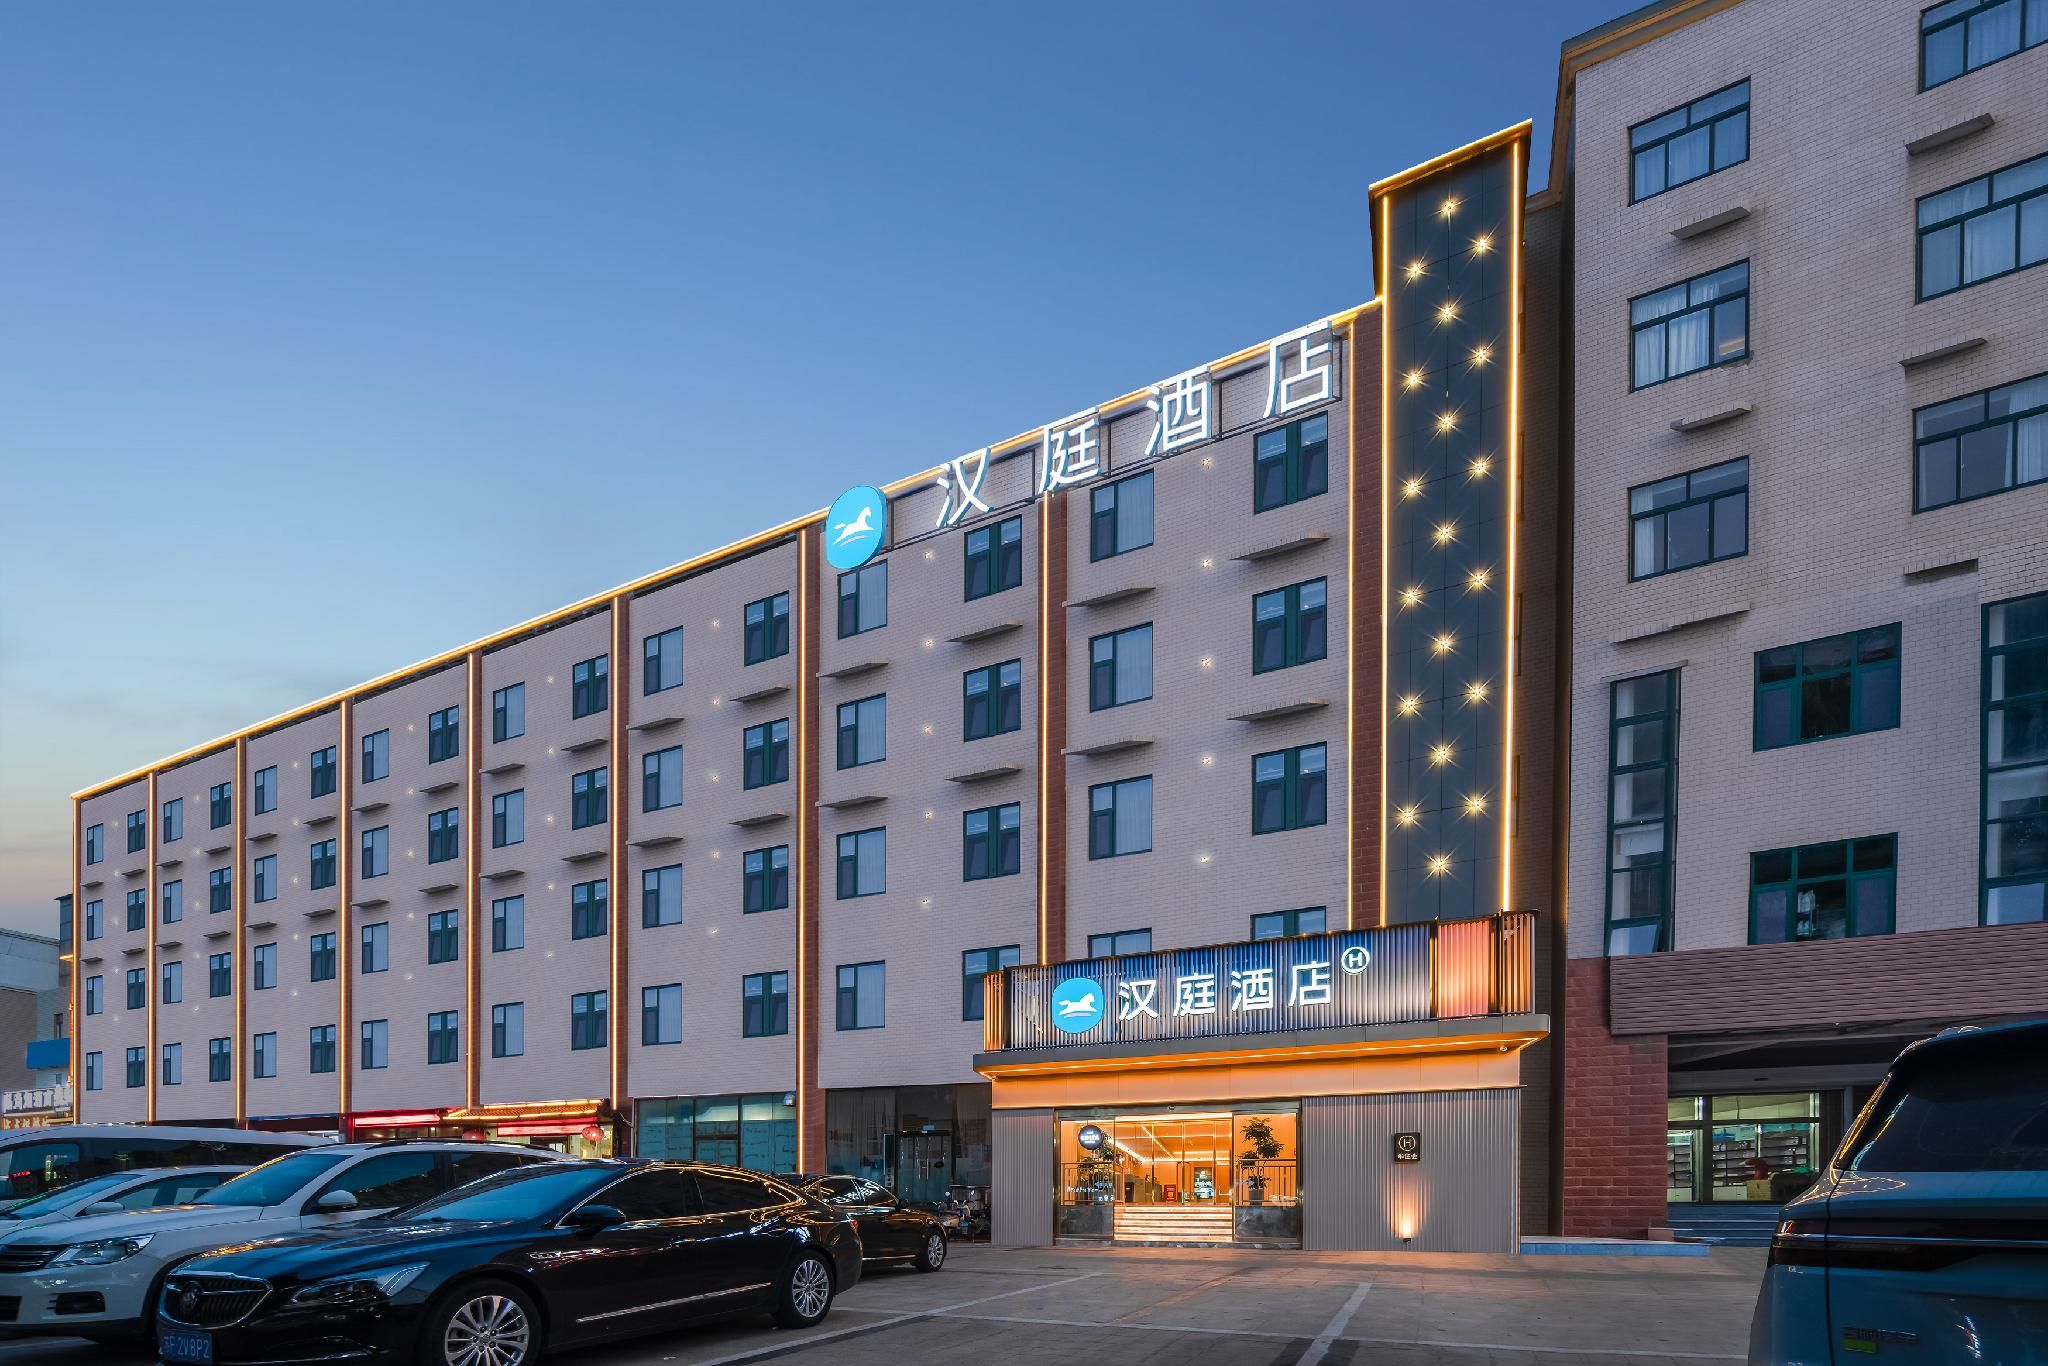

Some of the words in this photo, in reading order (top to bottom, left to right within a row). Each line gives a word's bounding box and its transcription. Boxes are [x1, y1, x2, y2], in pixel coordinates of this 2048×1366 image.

[935, 320, 1334, 528] 汉庭酒店
[1118, 961, 1331, 1020] 汉庭酒店
